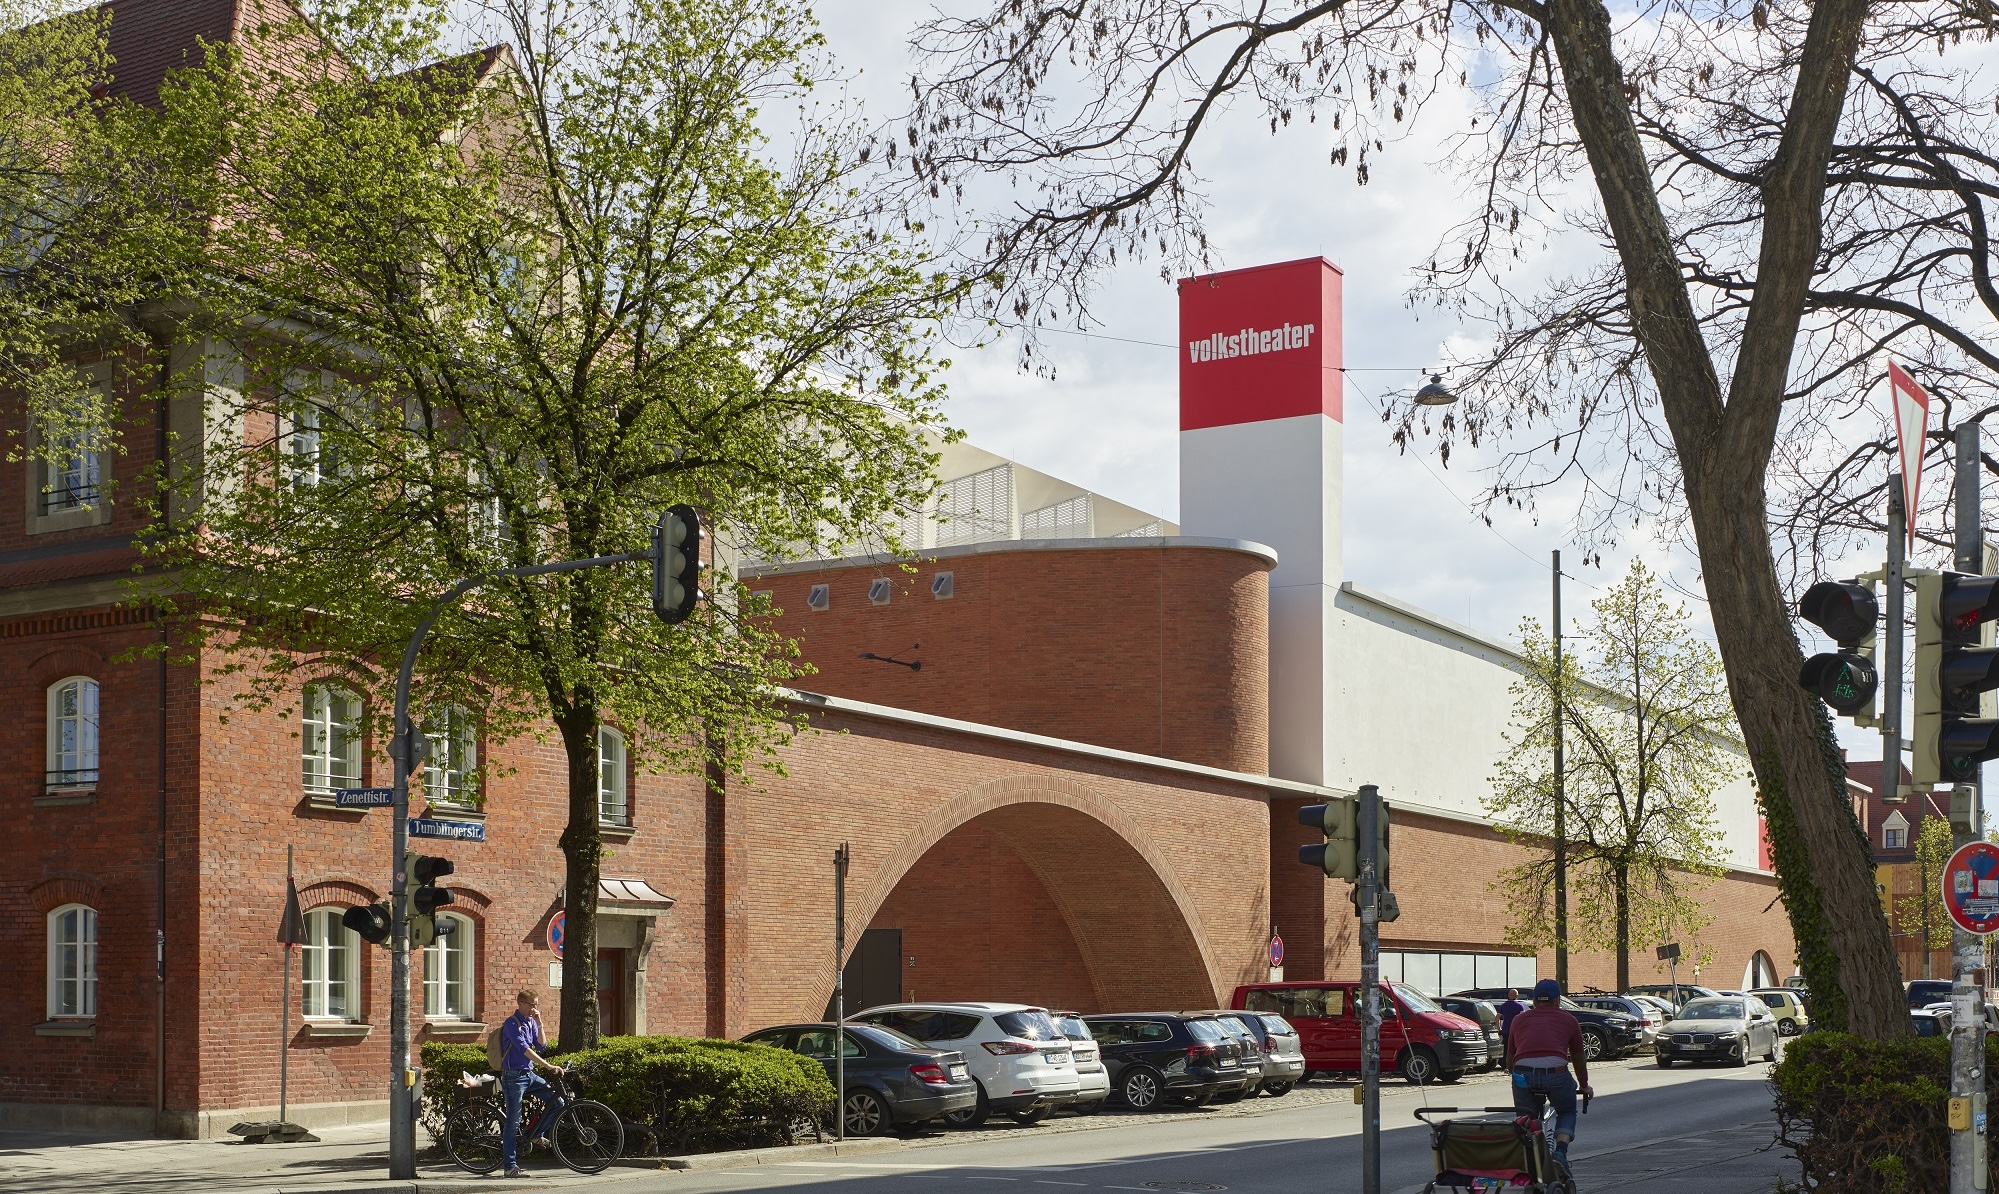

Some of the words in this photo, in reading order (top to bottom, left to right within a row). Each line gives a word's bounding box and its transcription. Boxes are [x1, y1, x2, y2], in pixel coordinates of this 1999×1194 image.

[1189, 322, 1315, 364] volkstheater
[340, 790, 390, 804] Zenettistr.
[414, 820, 482, 839] Tumblingerstr.
